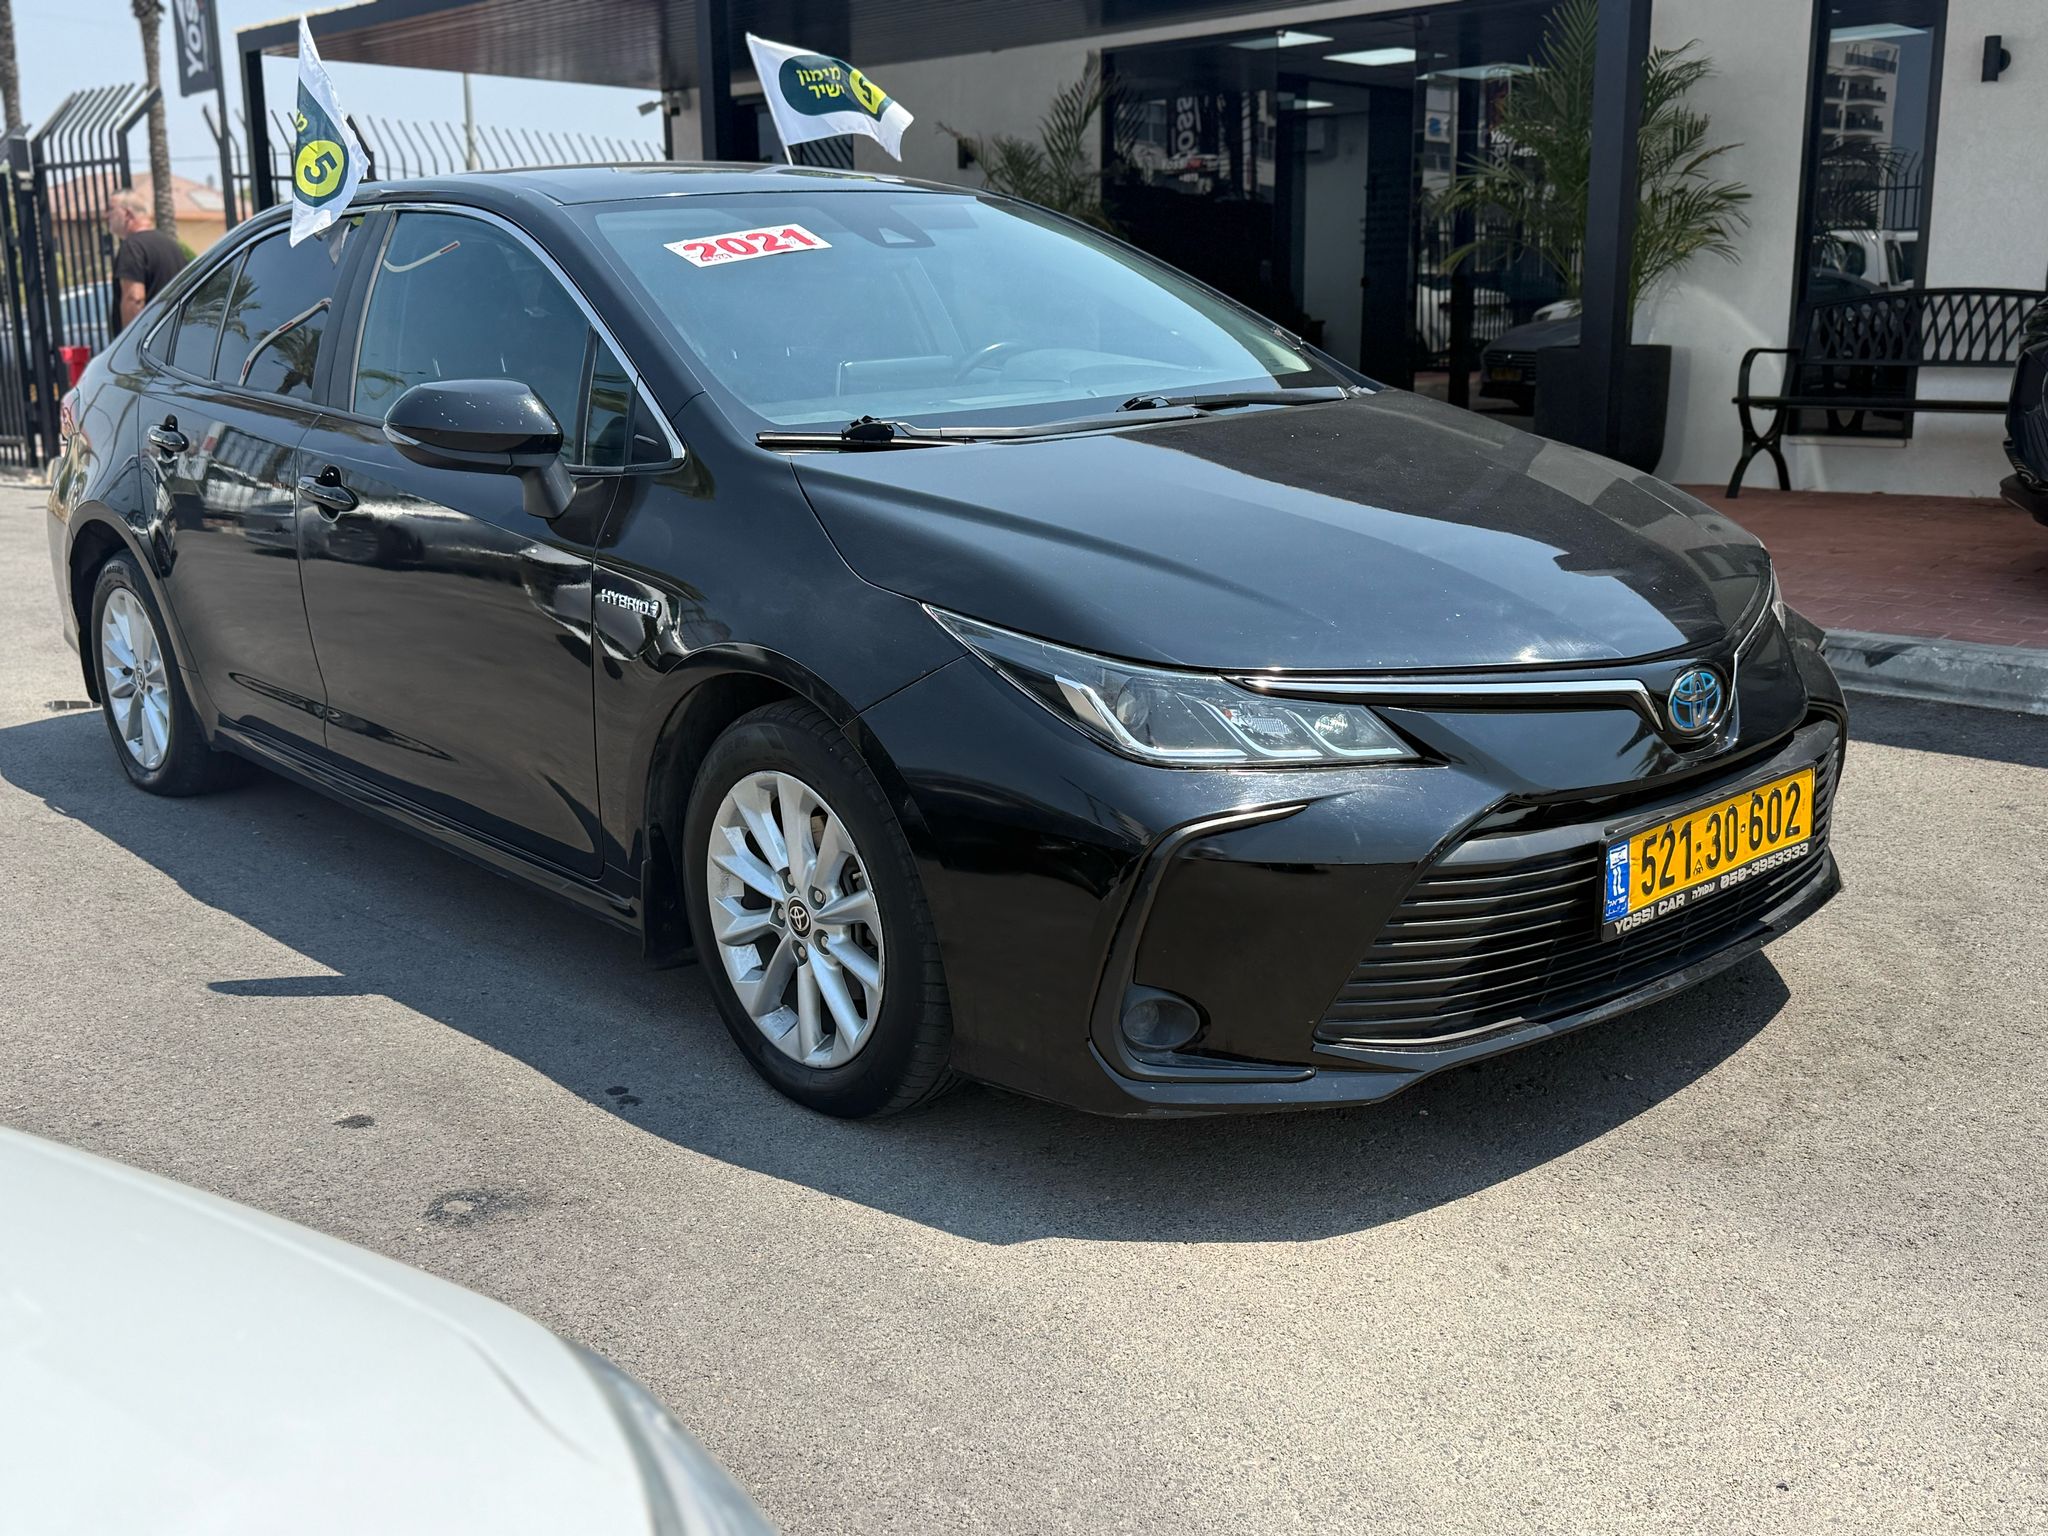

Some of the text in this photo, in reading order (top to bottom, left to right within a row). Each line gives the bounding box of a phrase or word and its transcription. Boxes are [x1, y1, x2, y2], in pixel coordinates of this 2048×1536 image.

[795, 66, 841, 86] מימון
[304, 151, 338, 185] 5
[683, 228, 818, 262] 2021
[601, 588, 649, 615] HYBRID
[1612, 866, 1626, 897] IL
[1614, 905, 1655, 935] YOSSI
[1657, 893, 1686, 915] CAR
